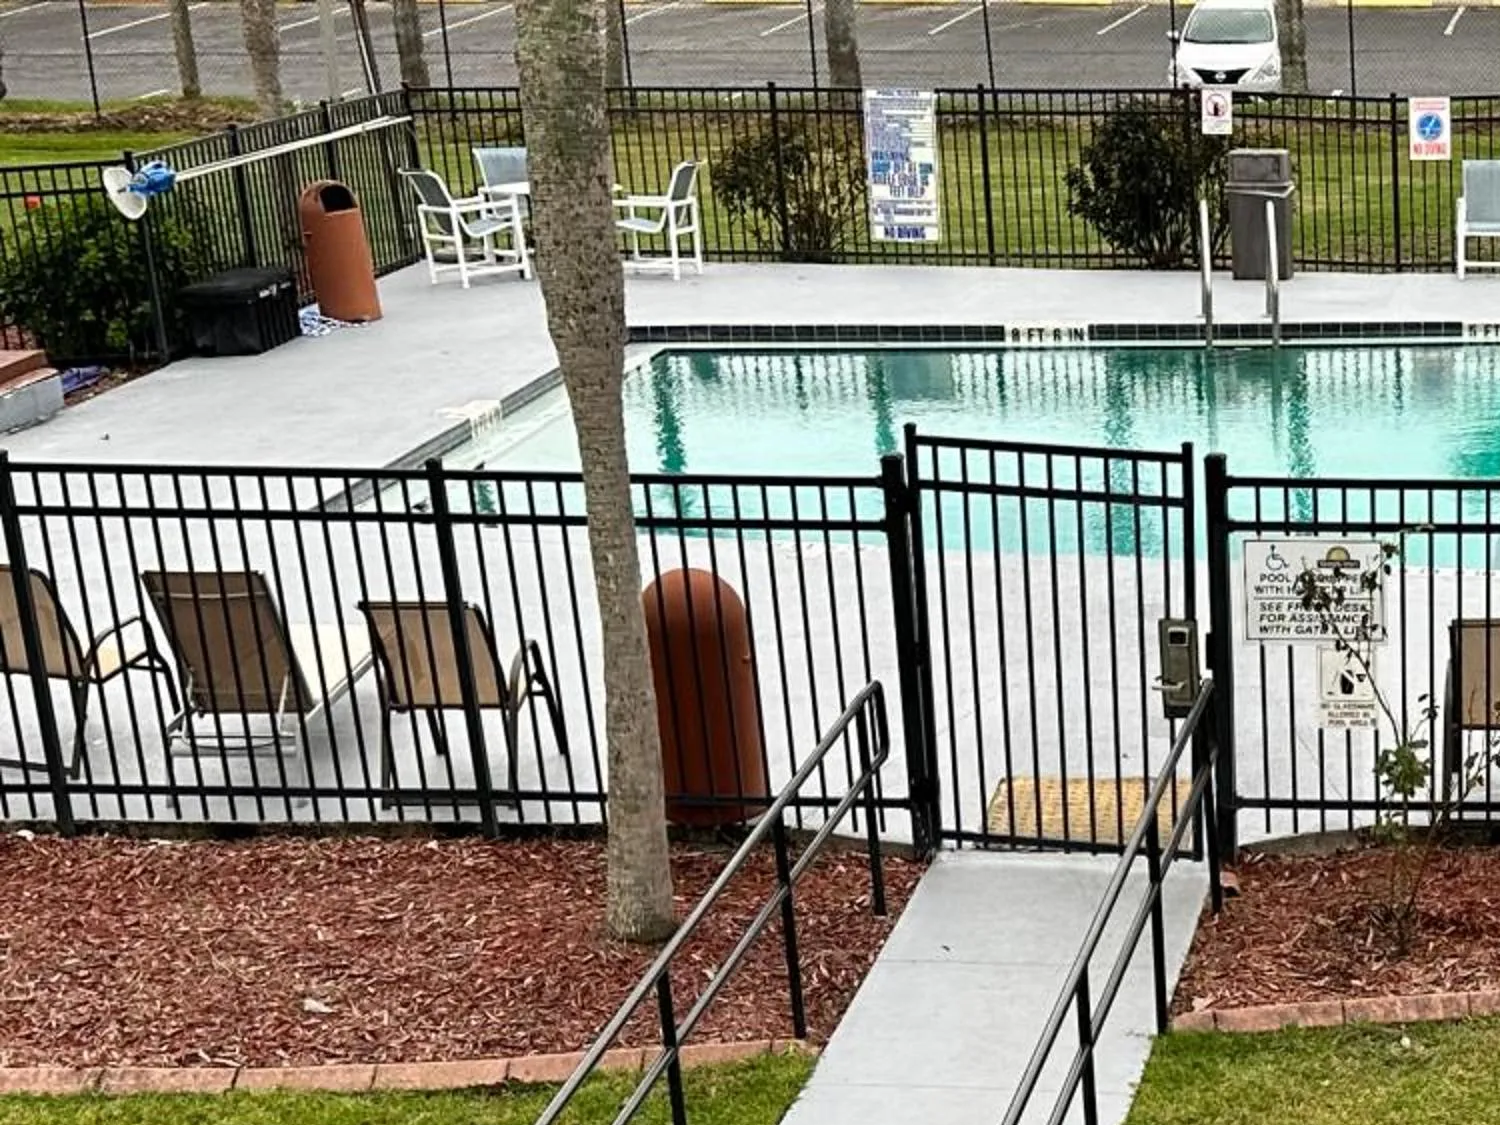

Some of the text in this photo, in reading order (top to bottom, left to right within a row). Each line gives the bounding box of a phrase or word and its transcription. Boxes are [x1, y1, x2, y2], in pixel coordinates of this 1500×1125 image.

[1027, 327, 1045, 342] FT
[1068, 327, 1084, 342] IN
[1259, 573, 1291, 583] POOL
[1255, 585, 1283, 595] WITH
[1259, 602, 1284, 612] SEE
[1259, 613, 1286, 623] FOR
[1259, 625, 1290, 634] WITH
